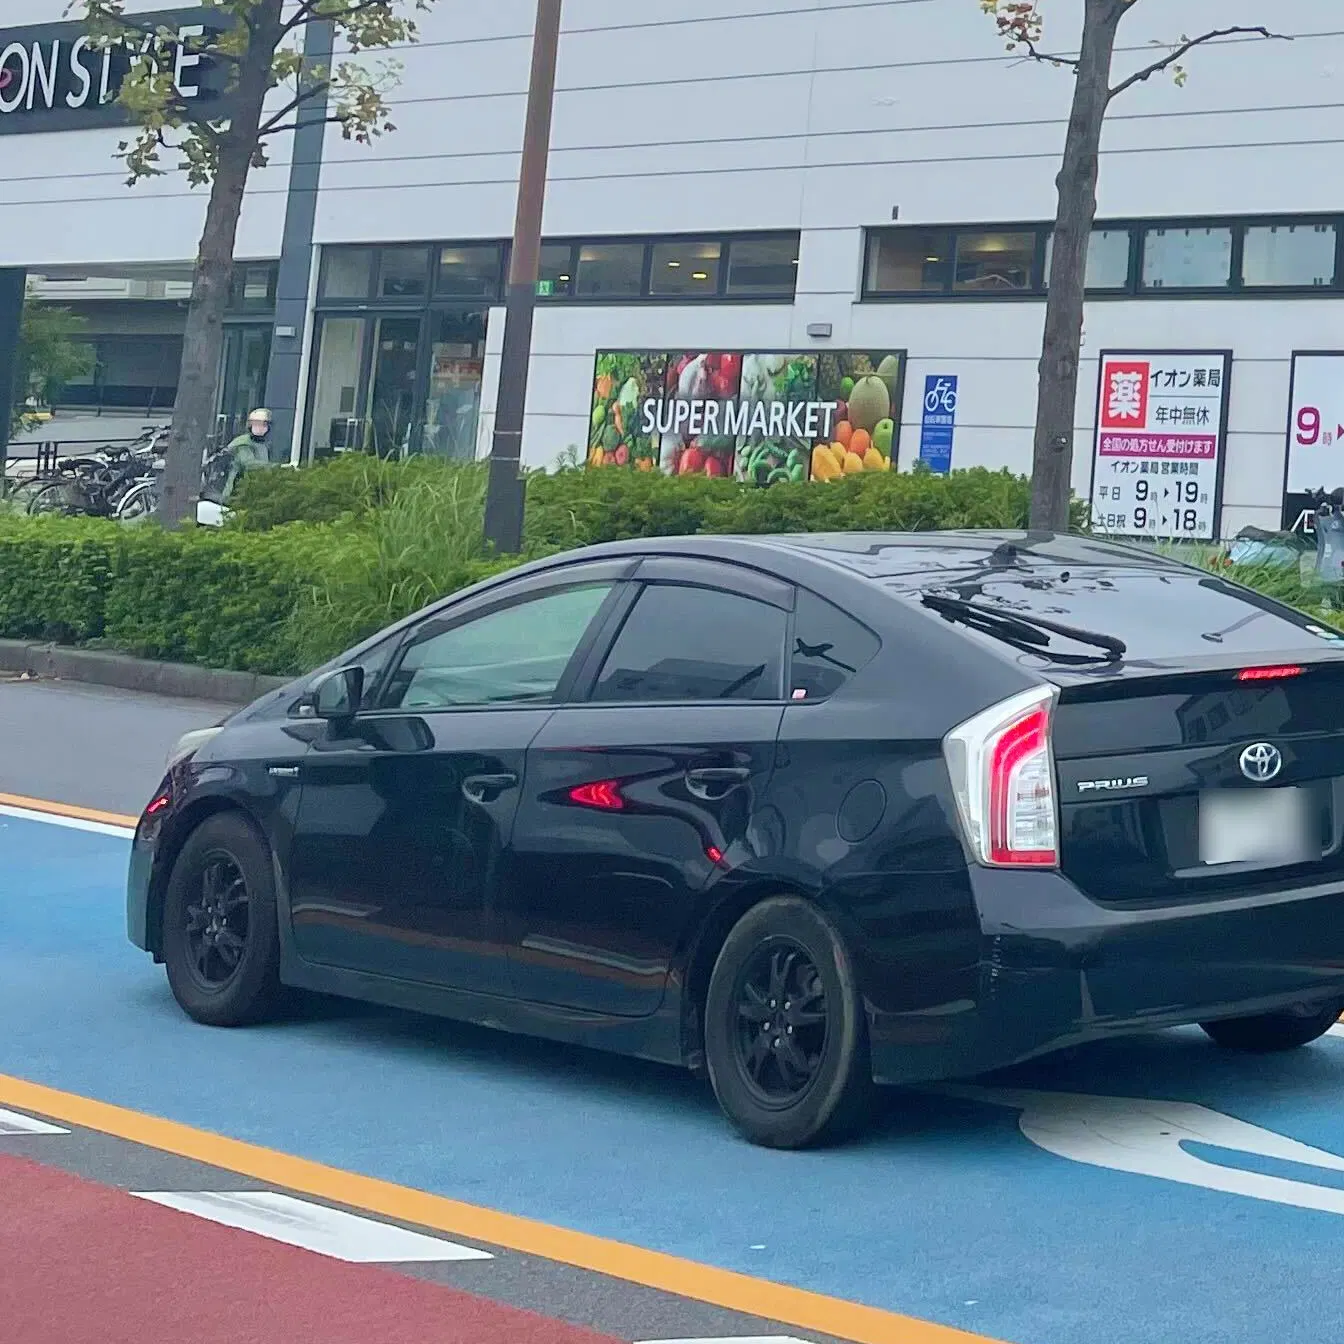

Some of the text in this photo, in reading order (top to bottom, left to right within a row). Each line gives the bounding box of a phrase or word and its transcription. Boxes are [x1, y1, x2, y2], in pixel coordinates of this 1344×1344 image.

[1150, 368, 1221, 388] イオン薬局
[1107, 370, 1143, 419] 薬
[641, 398, 837, 438] SUPER MARKET
[1155, 405, 1210, 426] 年中無休
[1102, 437, 1213, 455] 全国の処方せん受付けます
[1077, 776, 1149, 792] PRIUS
